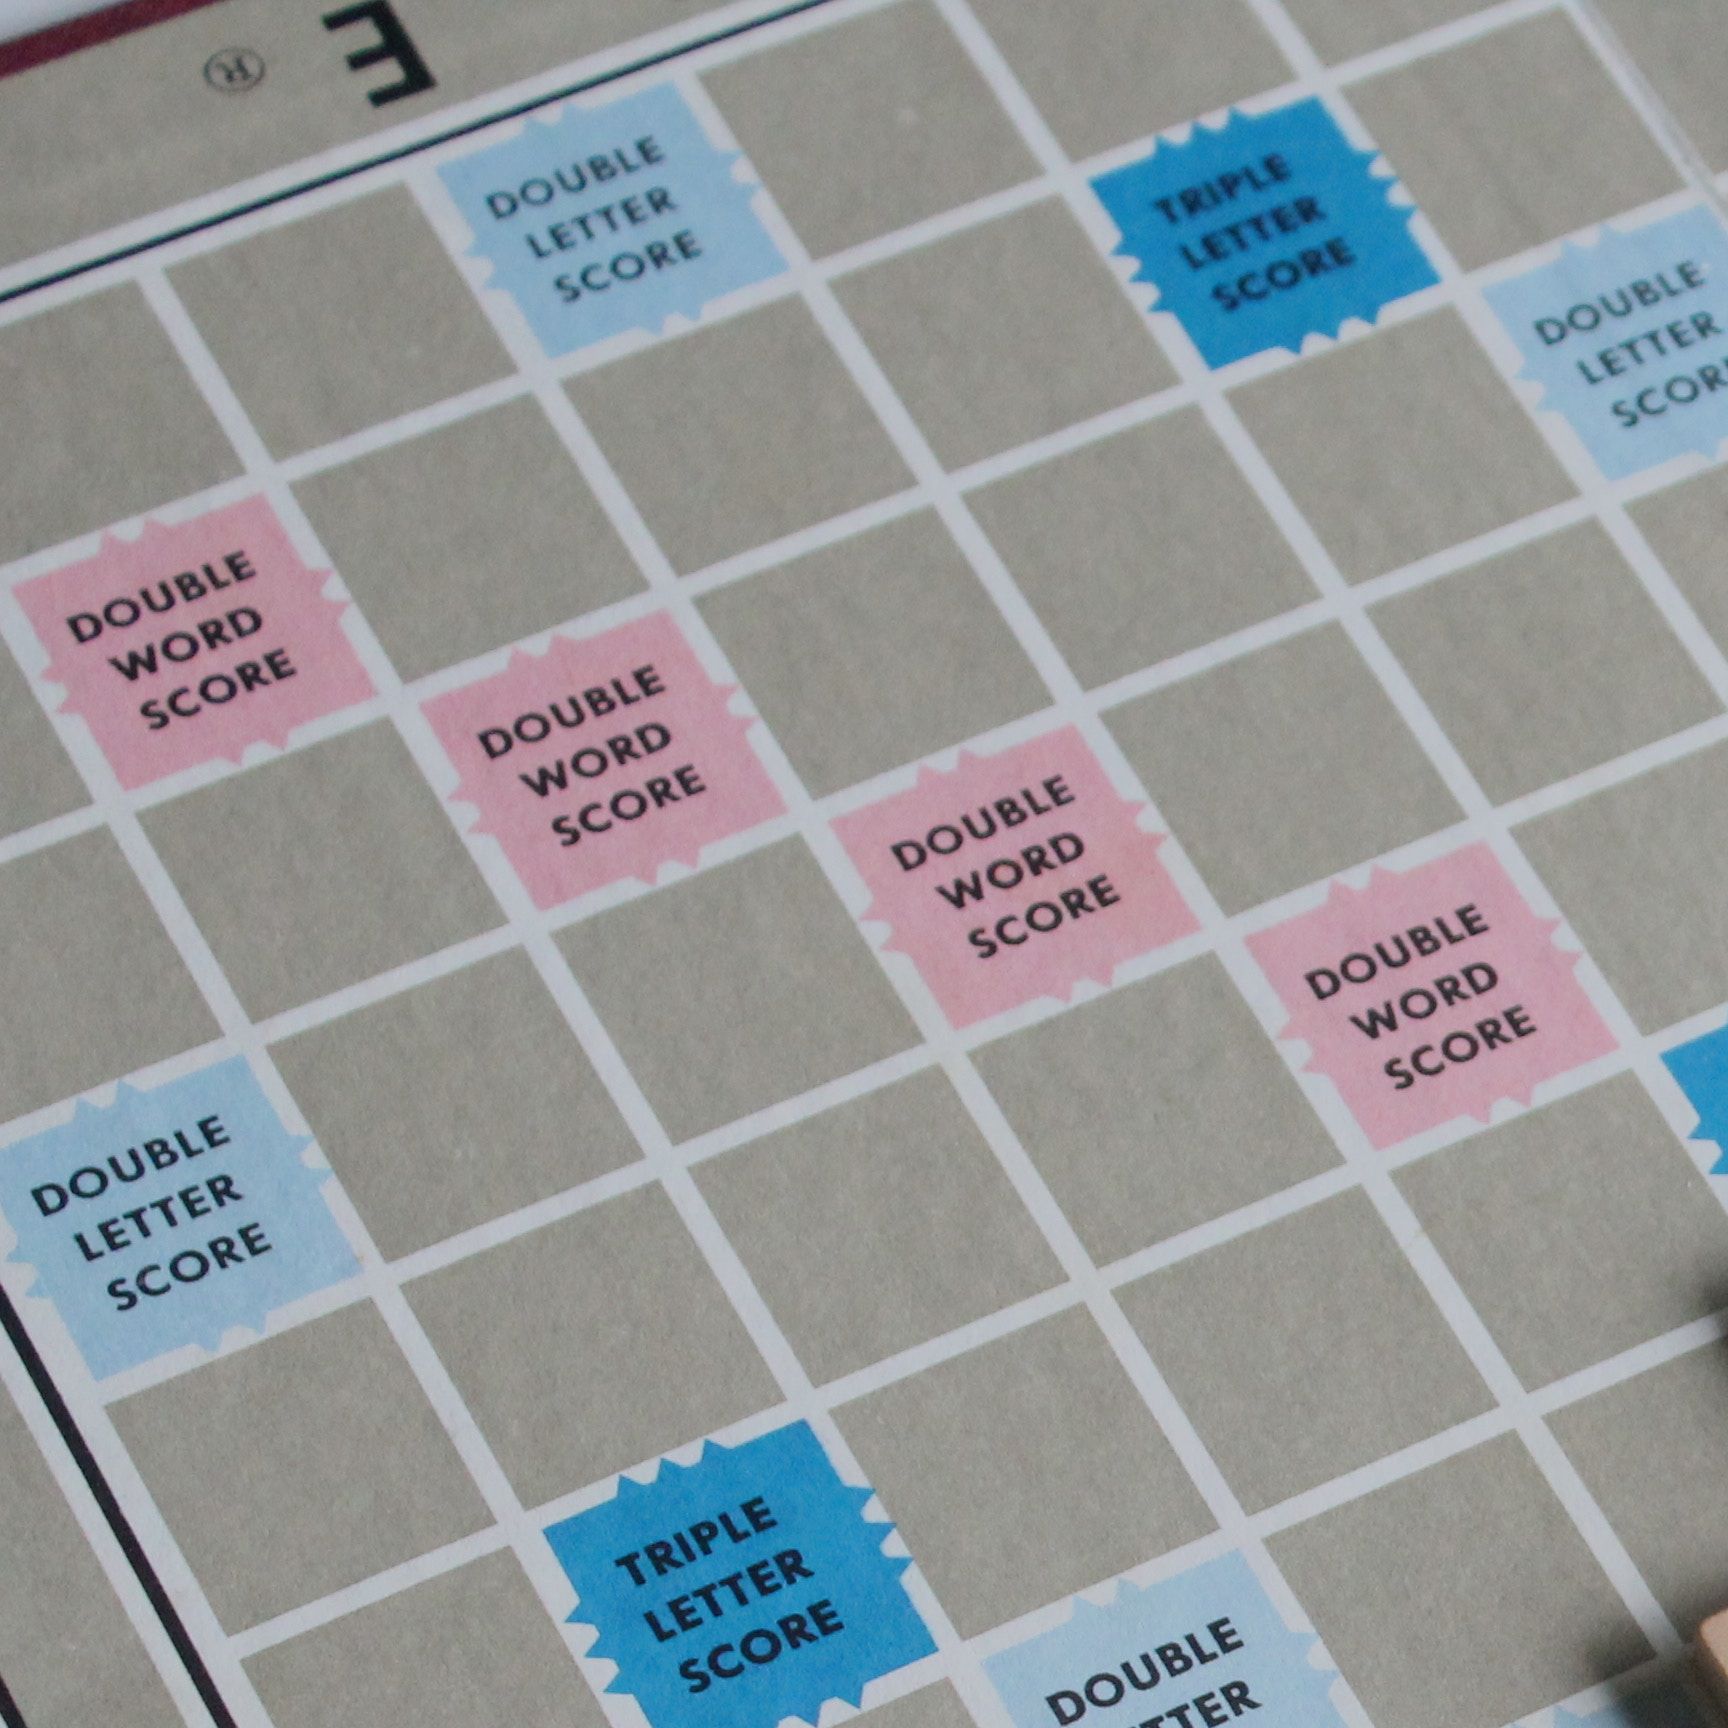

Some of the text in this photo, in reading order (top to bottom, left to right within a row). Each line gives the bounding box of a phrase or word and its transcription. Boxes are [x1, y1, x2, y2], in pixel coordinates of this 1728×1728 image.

[484, 135, 665, 222] DOUBLE
[1152, 153, 1292, 226] TRIPLE
[524, 186, 677, 261] LETTER
[552, 230, 703, 304] SCORE
[1178, 196, 1327, 272] LETTER
[1210, 237, 1356, 314] SCORE
[1532, 260, 1705, 348] DOUBLE
[1575, 311, 1723, 387] LETTER
[65, 550, 257, 646] DOUBLE
[107, 605, 264, 683] WORD
[138, 647, 298, 732] SCORE
[476, 663, 667, 761] DOUBLE
[517, 721, 673, 799] WORD
[550, 763, 707, 848] SCORE
[889, 774, 1077, 873] DOUBLE
[934, 831, 1086, 911] WORD
[966, 873, 1122, 961] SCORE
[1303, 902, 1491, 1002] DOUBLE
[1347, 961, 1500, 1041] WORD
[1382, 1003, 1538, 1091] SCORE
[29, 1114, 232, 1218] DOUBLE
[72, 1173, 244, 1263] LETTER
[105, 1221, 274, 1313] SCORE
[613, 1495, 779, 1588] TRIPLE
[641, 1547, 816, 1644] LETTER
[677, 1598, 846, 1695] SCORE
[1044, 1615, 1246, 1728] DOUBLE
